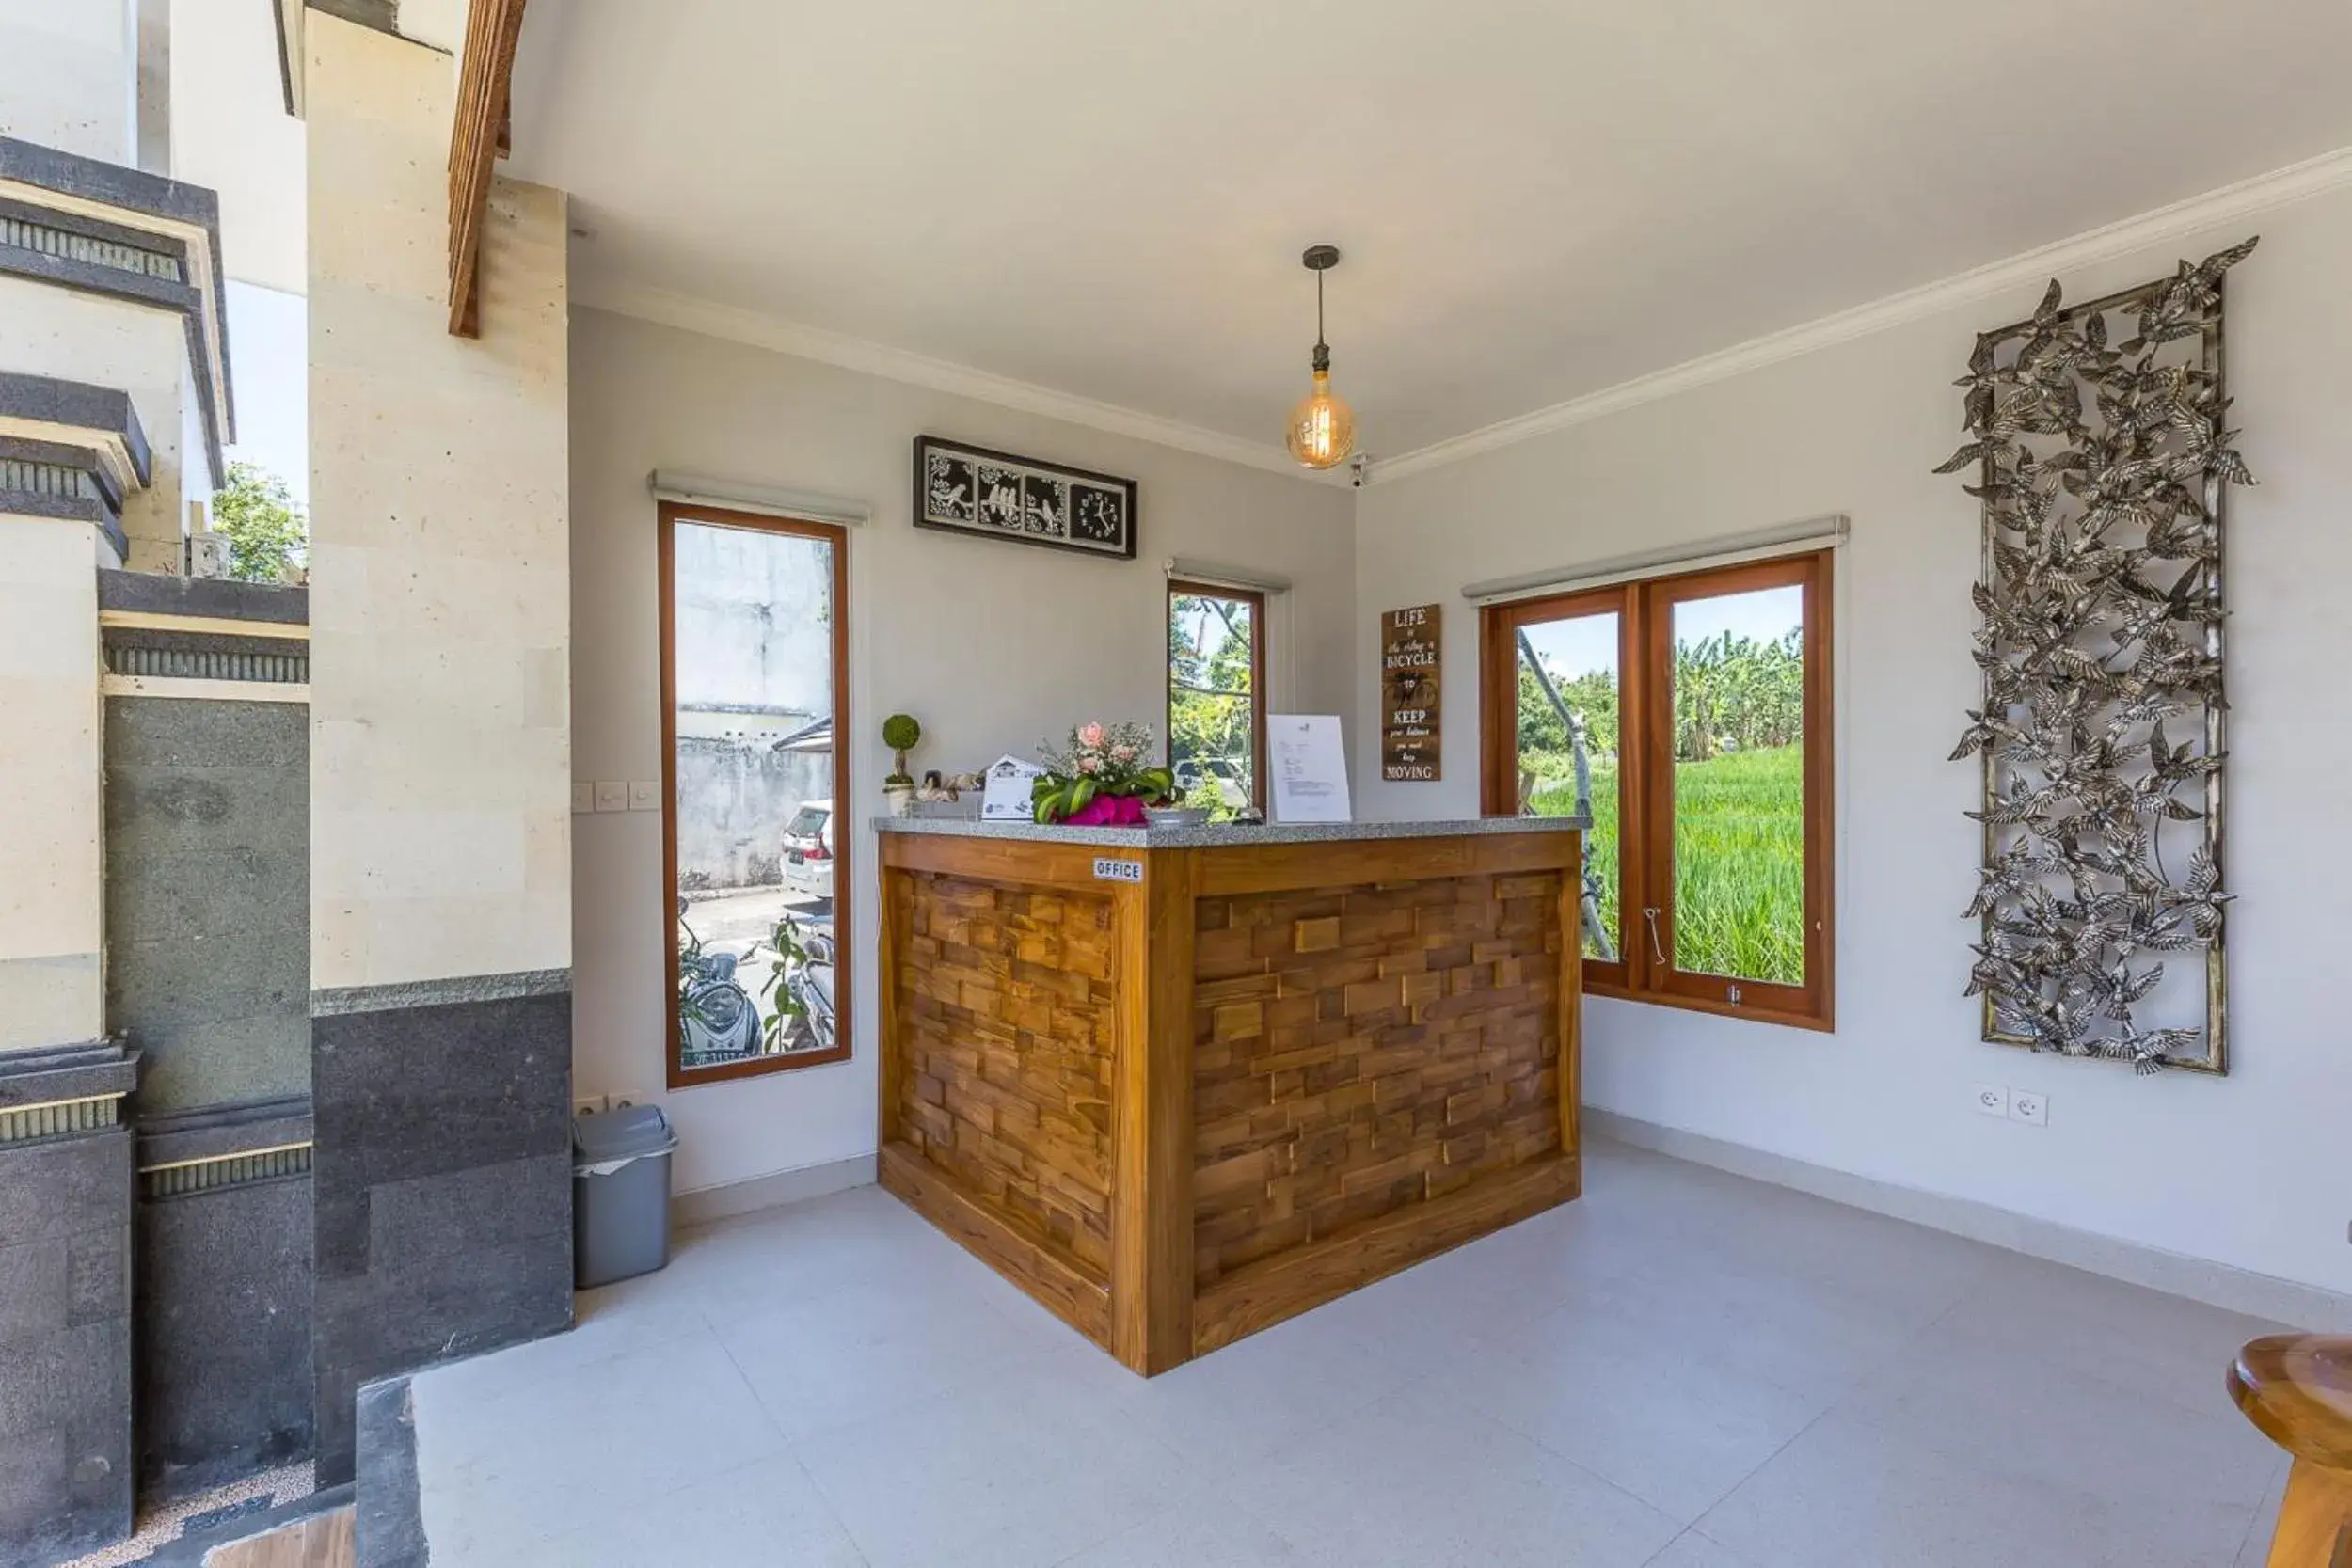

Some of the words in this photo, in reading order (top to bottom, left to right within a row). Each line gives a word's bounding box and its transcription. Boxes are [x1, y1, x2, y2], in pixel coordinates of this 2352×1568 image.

[1394, 608, 1426, 628] LIFE
[1387, 651, 1436, 668] BICYCLE
[1393, 709, 1426, 724] KEEP
[1387, 765, 1432, 779] MOVING
[1097, 862, 1139, 878] OFFICE
